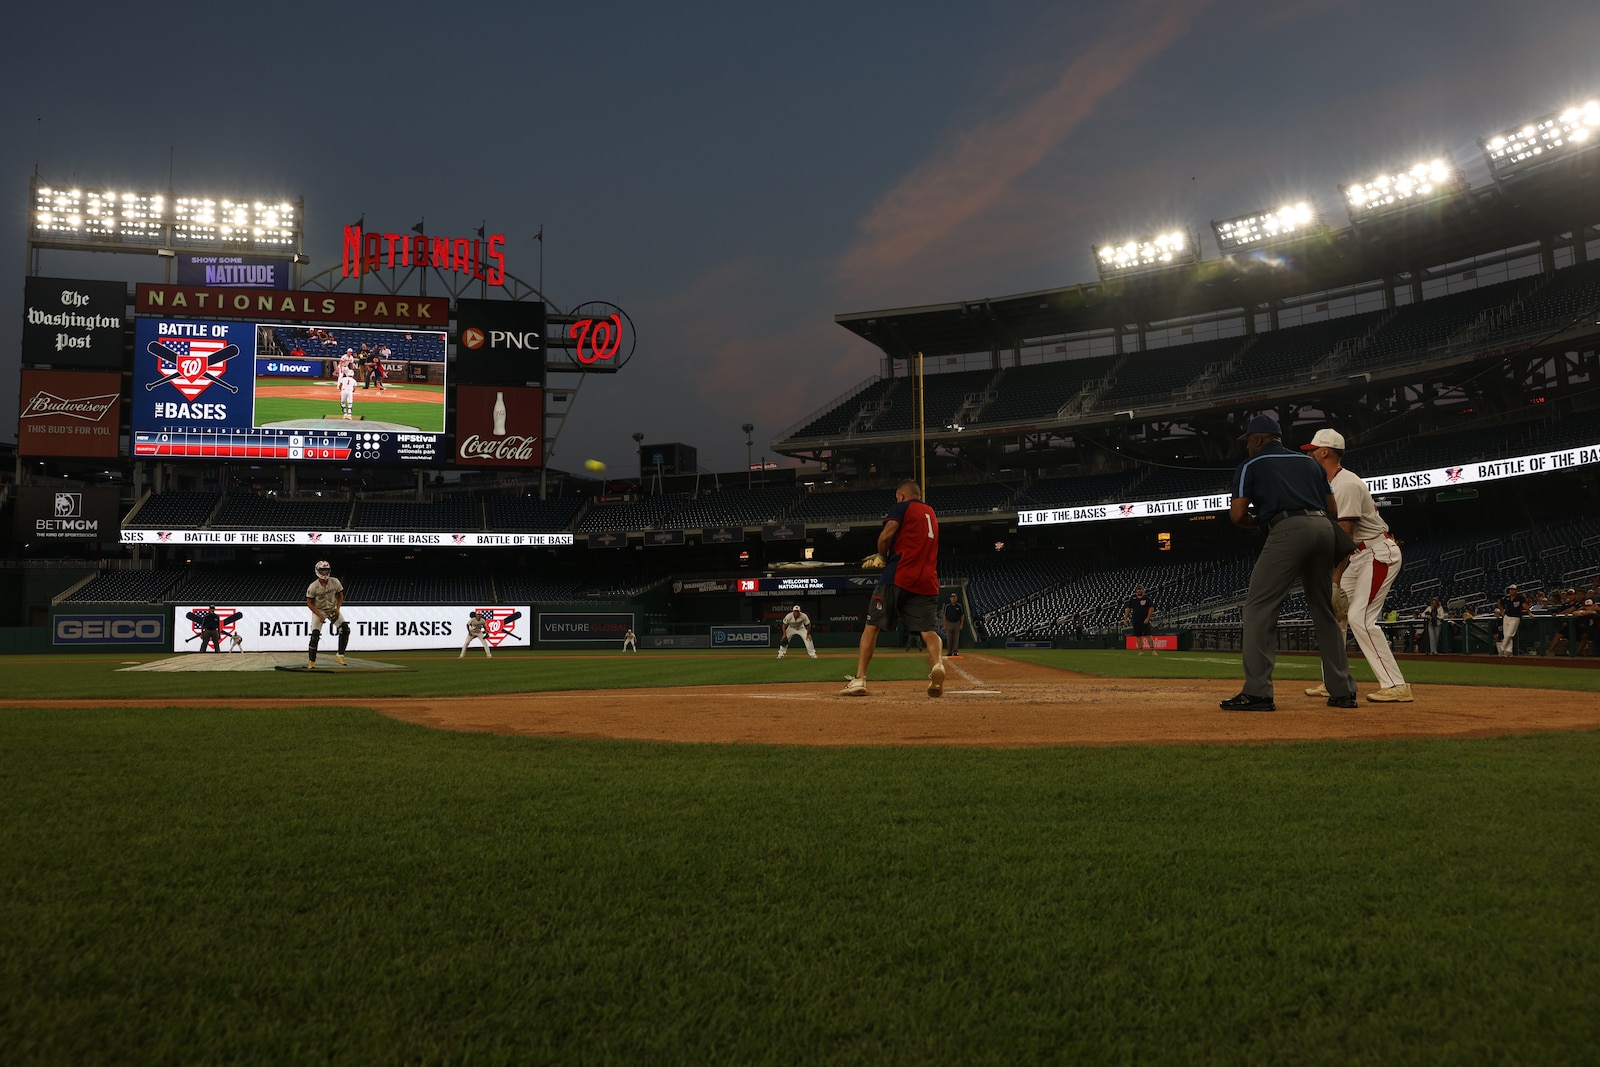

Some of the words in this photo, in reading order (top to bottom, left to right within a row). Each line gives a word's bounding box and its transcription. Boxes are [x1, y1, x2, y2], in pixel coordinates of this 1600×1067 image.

[342, 224, 506, 286] NATIONALS
[206, 265, 274, 284] NATITUDE
[60, 290, 90, 307] The
[148, 290, 336, 314] NATIONALS
[354, 300, 432, 318] PARK
[27, 307, 120, 329] Washington
[158, 323, 207, 336] BATTLE
[211, 325, 229, 337] OF
[570, 313, 622, 364] W
[55, 332, 92, 352] Post
[489, 330, 540, 350] PNC
[280, 363, 311, 373] Inova
[30, 394, 110, 413] Budweiser
[155, 402, 164, 418] THE
[165, 402, 227, 420] BASES
[27, 425, 47, 434] THIS
[48, 425, 73, 434] BUD'S
[75, 426, 90, 435] FOR
[92, 426, 111, 436] YOU.
[397, 434, 436, 443] HFStival
[460, 434, 537, 461] Coca-Cola
[1478, 459, 1525, 478] BATTLE
[1529, 458, 1546, 470] OF
[1550, 452, 1575, 468] THE
[1580, 447, 1600, 464] BA
[1366, 477, 1388, 492] THE
[1393, 473, 1430, 490] BASES
[1036, 512, 1049, 521] OF
[1052, 510, 1070, 520] THE
[1073, 507, 1106, 519] BASES
[1147, 501, 1183, 514] BATTLE
[1186, 500, 1199, 511] OF
[1202, 498, 1222, 509] THE
[36, 520, 98, 530] BETMGM
[925, 513, 934, 540] 1
[185, 532, 221, 542] BATTLE
[224, 533, 236, 542] OF
[240, 533, 259, 542] THE
[262, 533, 295, 543] BASES
[334, 534, 368, 543] BATTLE
[372, 534, 384, 543] OF
[387, 535, 405, 543] THE
[408, 535, 440, 543] BASES
[477, 536, 511, 544] BATTLE
[514, 536, 526, 544] OF
[529, 536, 546, 544] THE
[57, 620, 161, 639] GEICO
[260, 622, 322, 636] BATTL
[357, 621, 389, 636] THE
[396, 621, 452, 636] BASES
[544, 623, 590, 632] VENTURE
[591, 623, 629, 632] GLOBAL
[727, 633, 768, 642] DABOS
